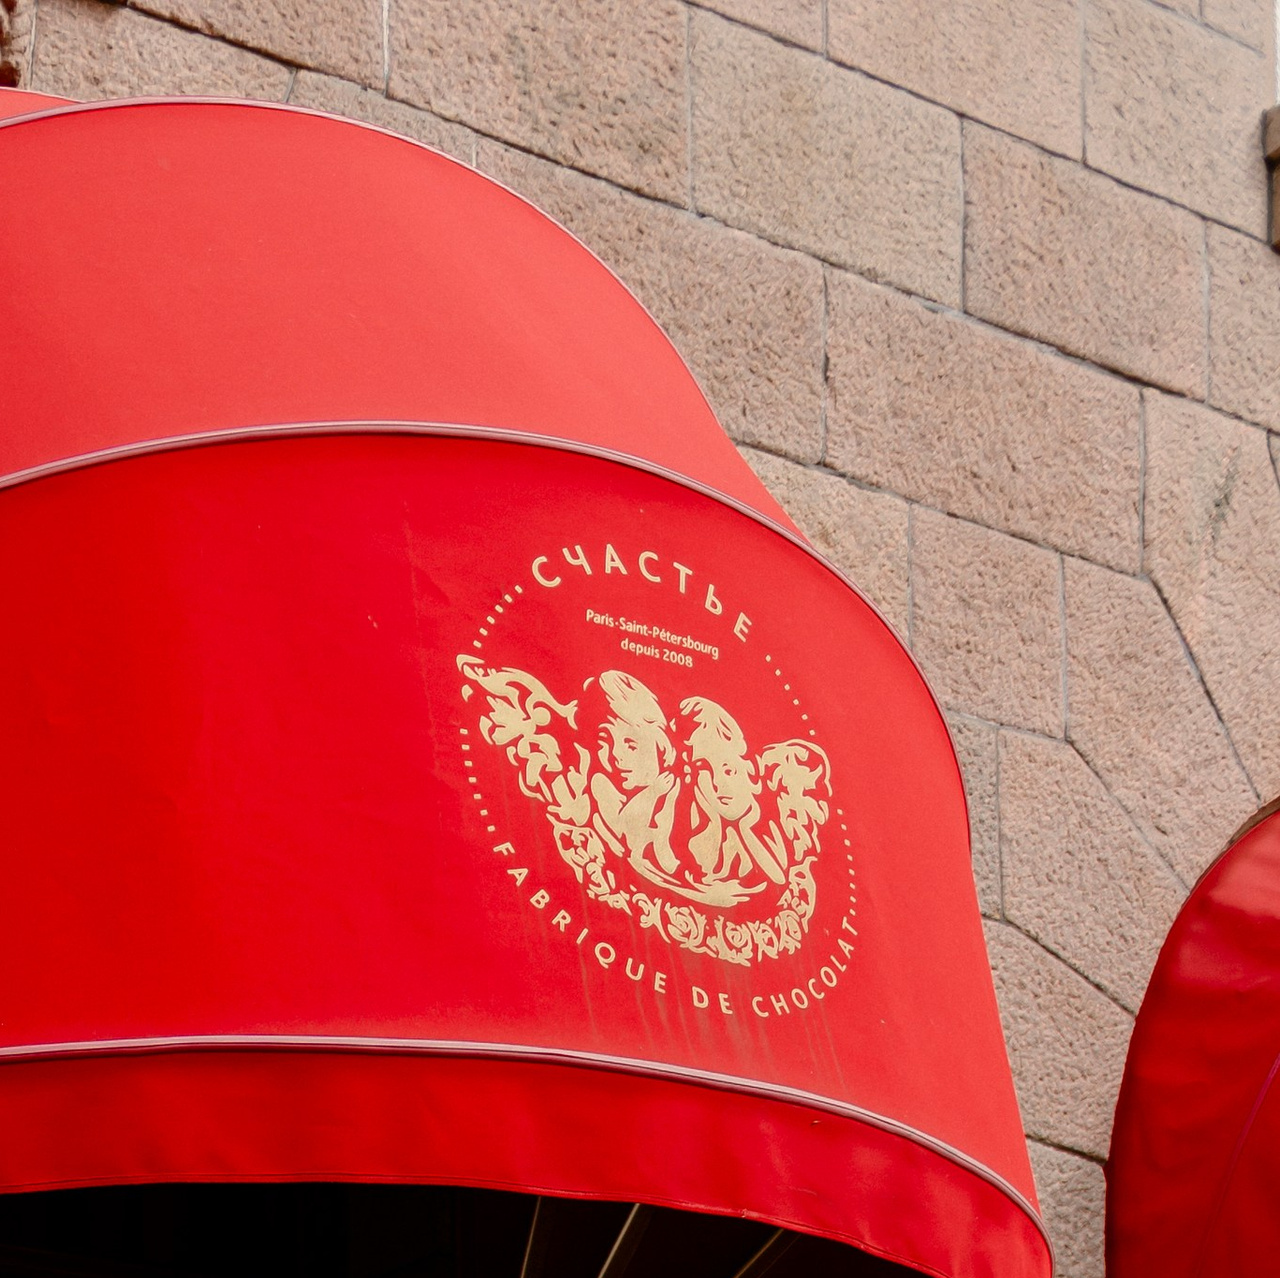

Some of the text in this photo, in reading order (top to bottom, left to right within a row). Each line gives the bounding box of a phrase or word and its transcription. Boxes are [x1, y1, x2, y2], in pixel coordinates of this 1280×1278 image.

[531, 543, 753, 643] СЧАСТЬЕ
[620, 637, 694, 668] depuis 2008
[492, 841, 859, 1018] FABRIQUE DE CHOCOLAT
